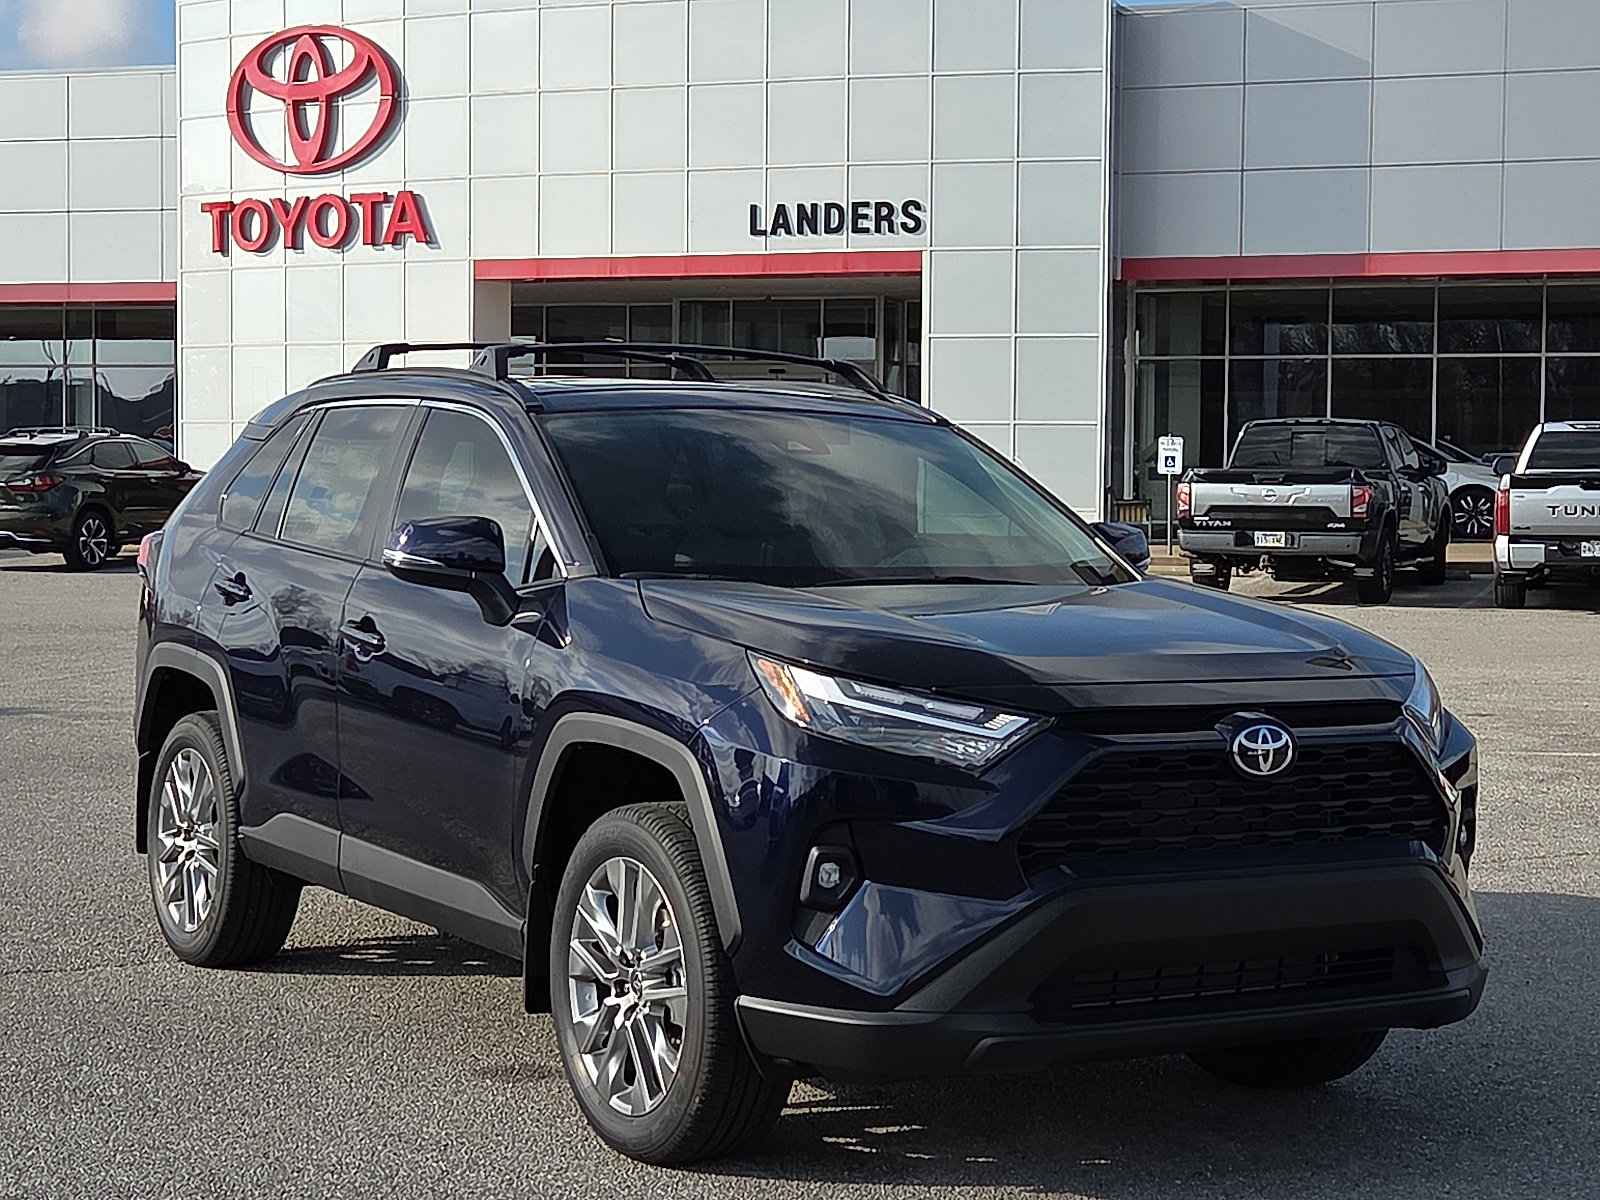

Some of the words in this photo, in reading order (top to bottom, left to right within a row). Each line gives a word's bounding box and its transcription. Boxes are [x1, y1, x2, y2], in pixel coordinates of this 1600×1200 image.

[201, 190, 429, 253] TOYOTA
[750, 200, 923, 235] LANDERS
[1546, 505, 1600, 517] TUN
